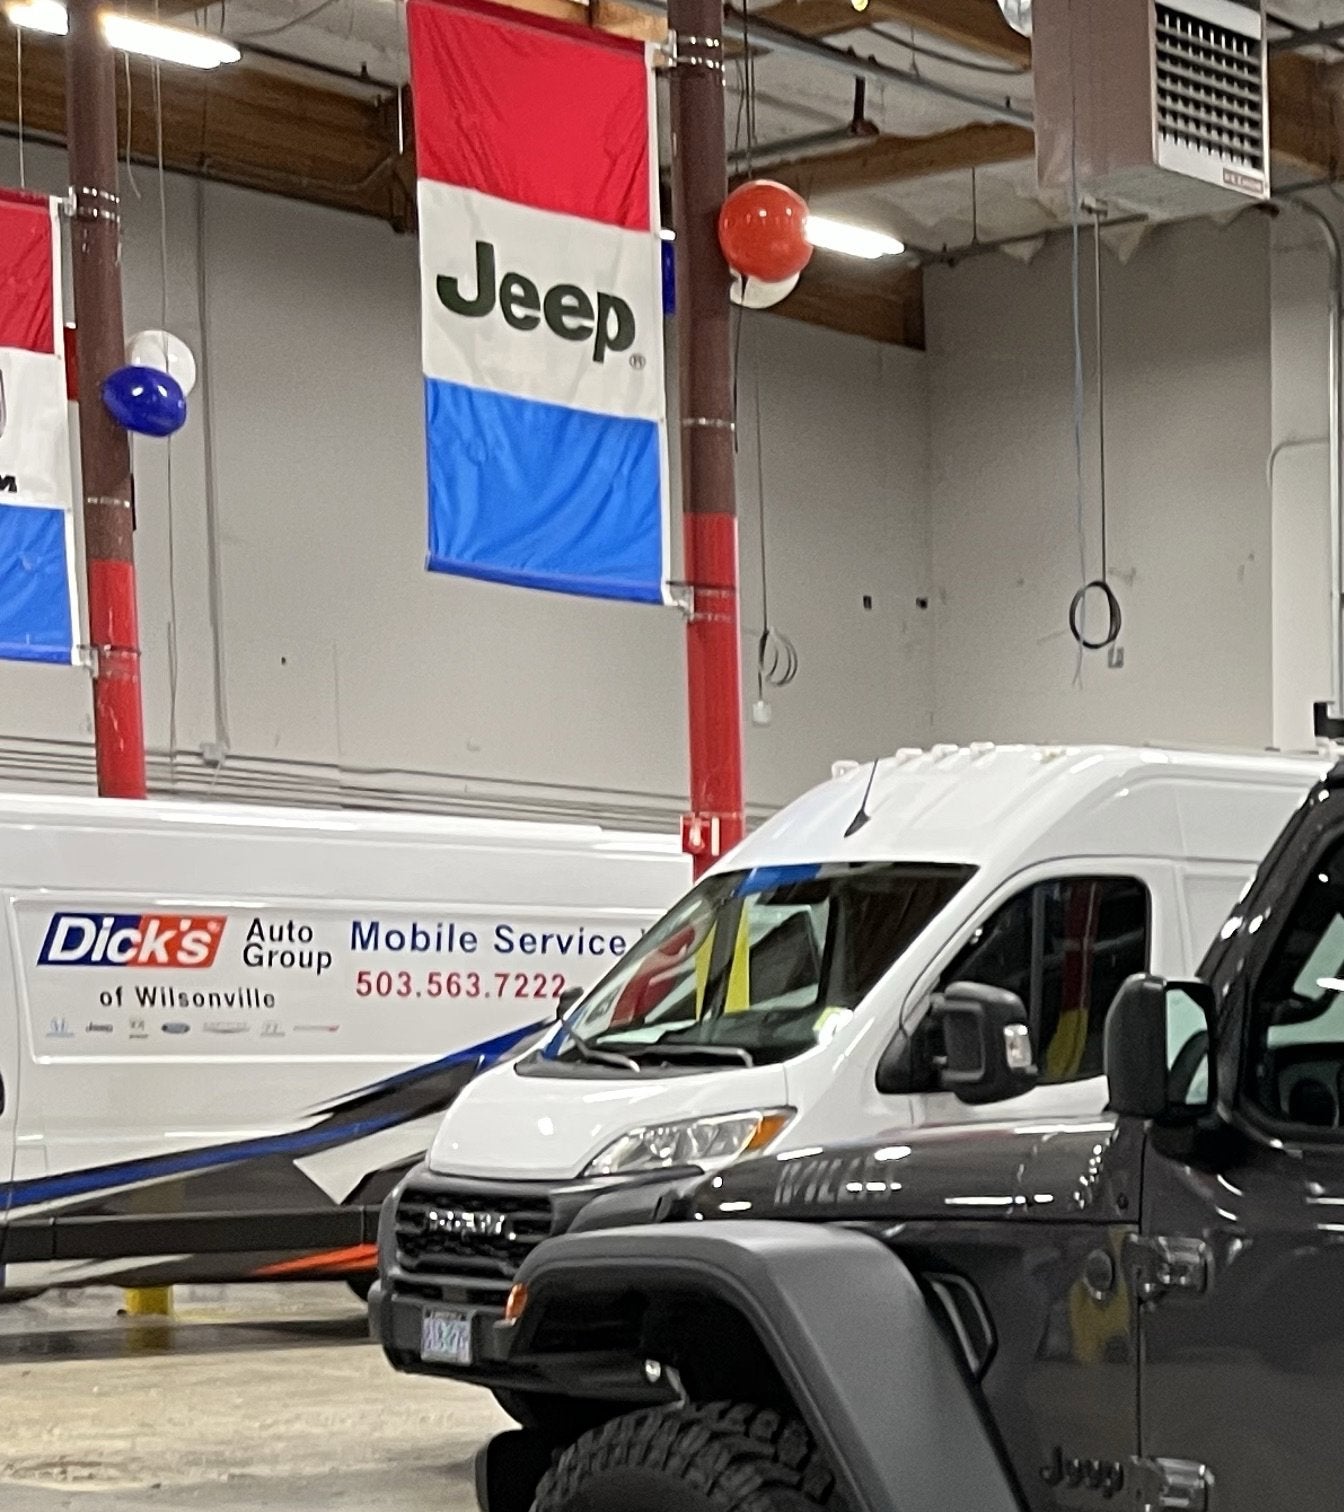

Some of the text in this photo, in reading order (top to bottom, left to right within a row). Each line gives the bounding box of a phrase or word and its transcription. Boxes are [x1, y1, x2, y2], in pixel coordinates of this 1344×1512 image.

[436, 240, 636, 364] Jeep
[246, 918, 313, 943] Auto
[351, 921, 626, 956] Mobile Service
[243, 943, 332, 976] Group
[100, 986, 276, 1008] of Wilsonville
[356, 971, 566, 998] 503.563.7222
